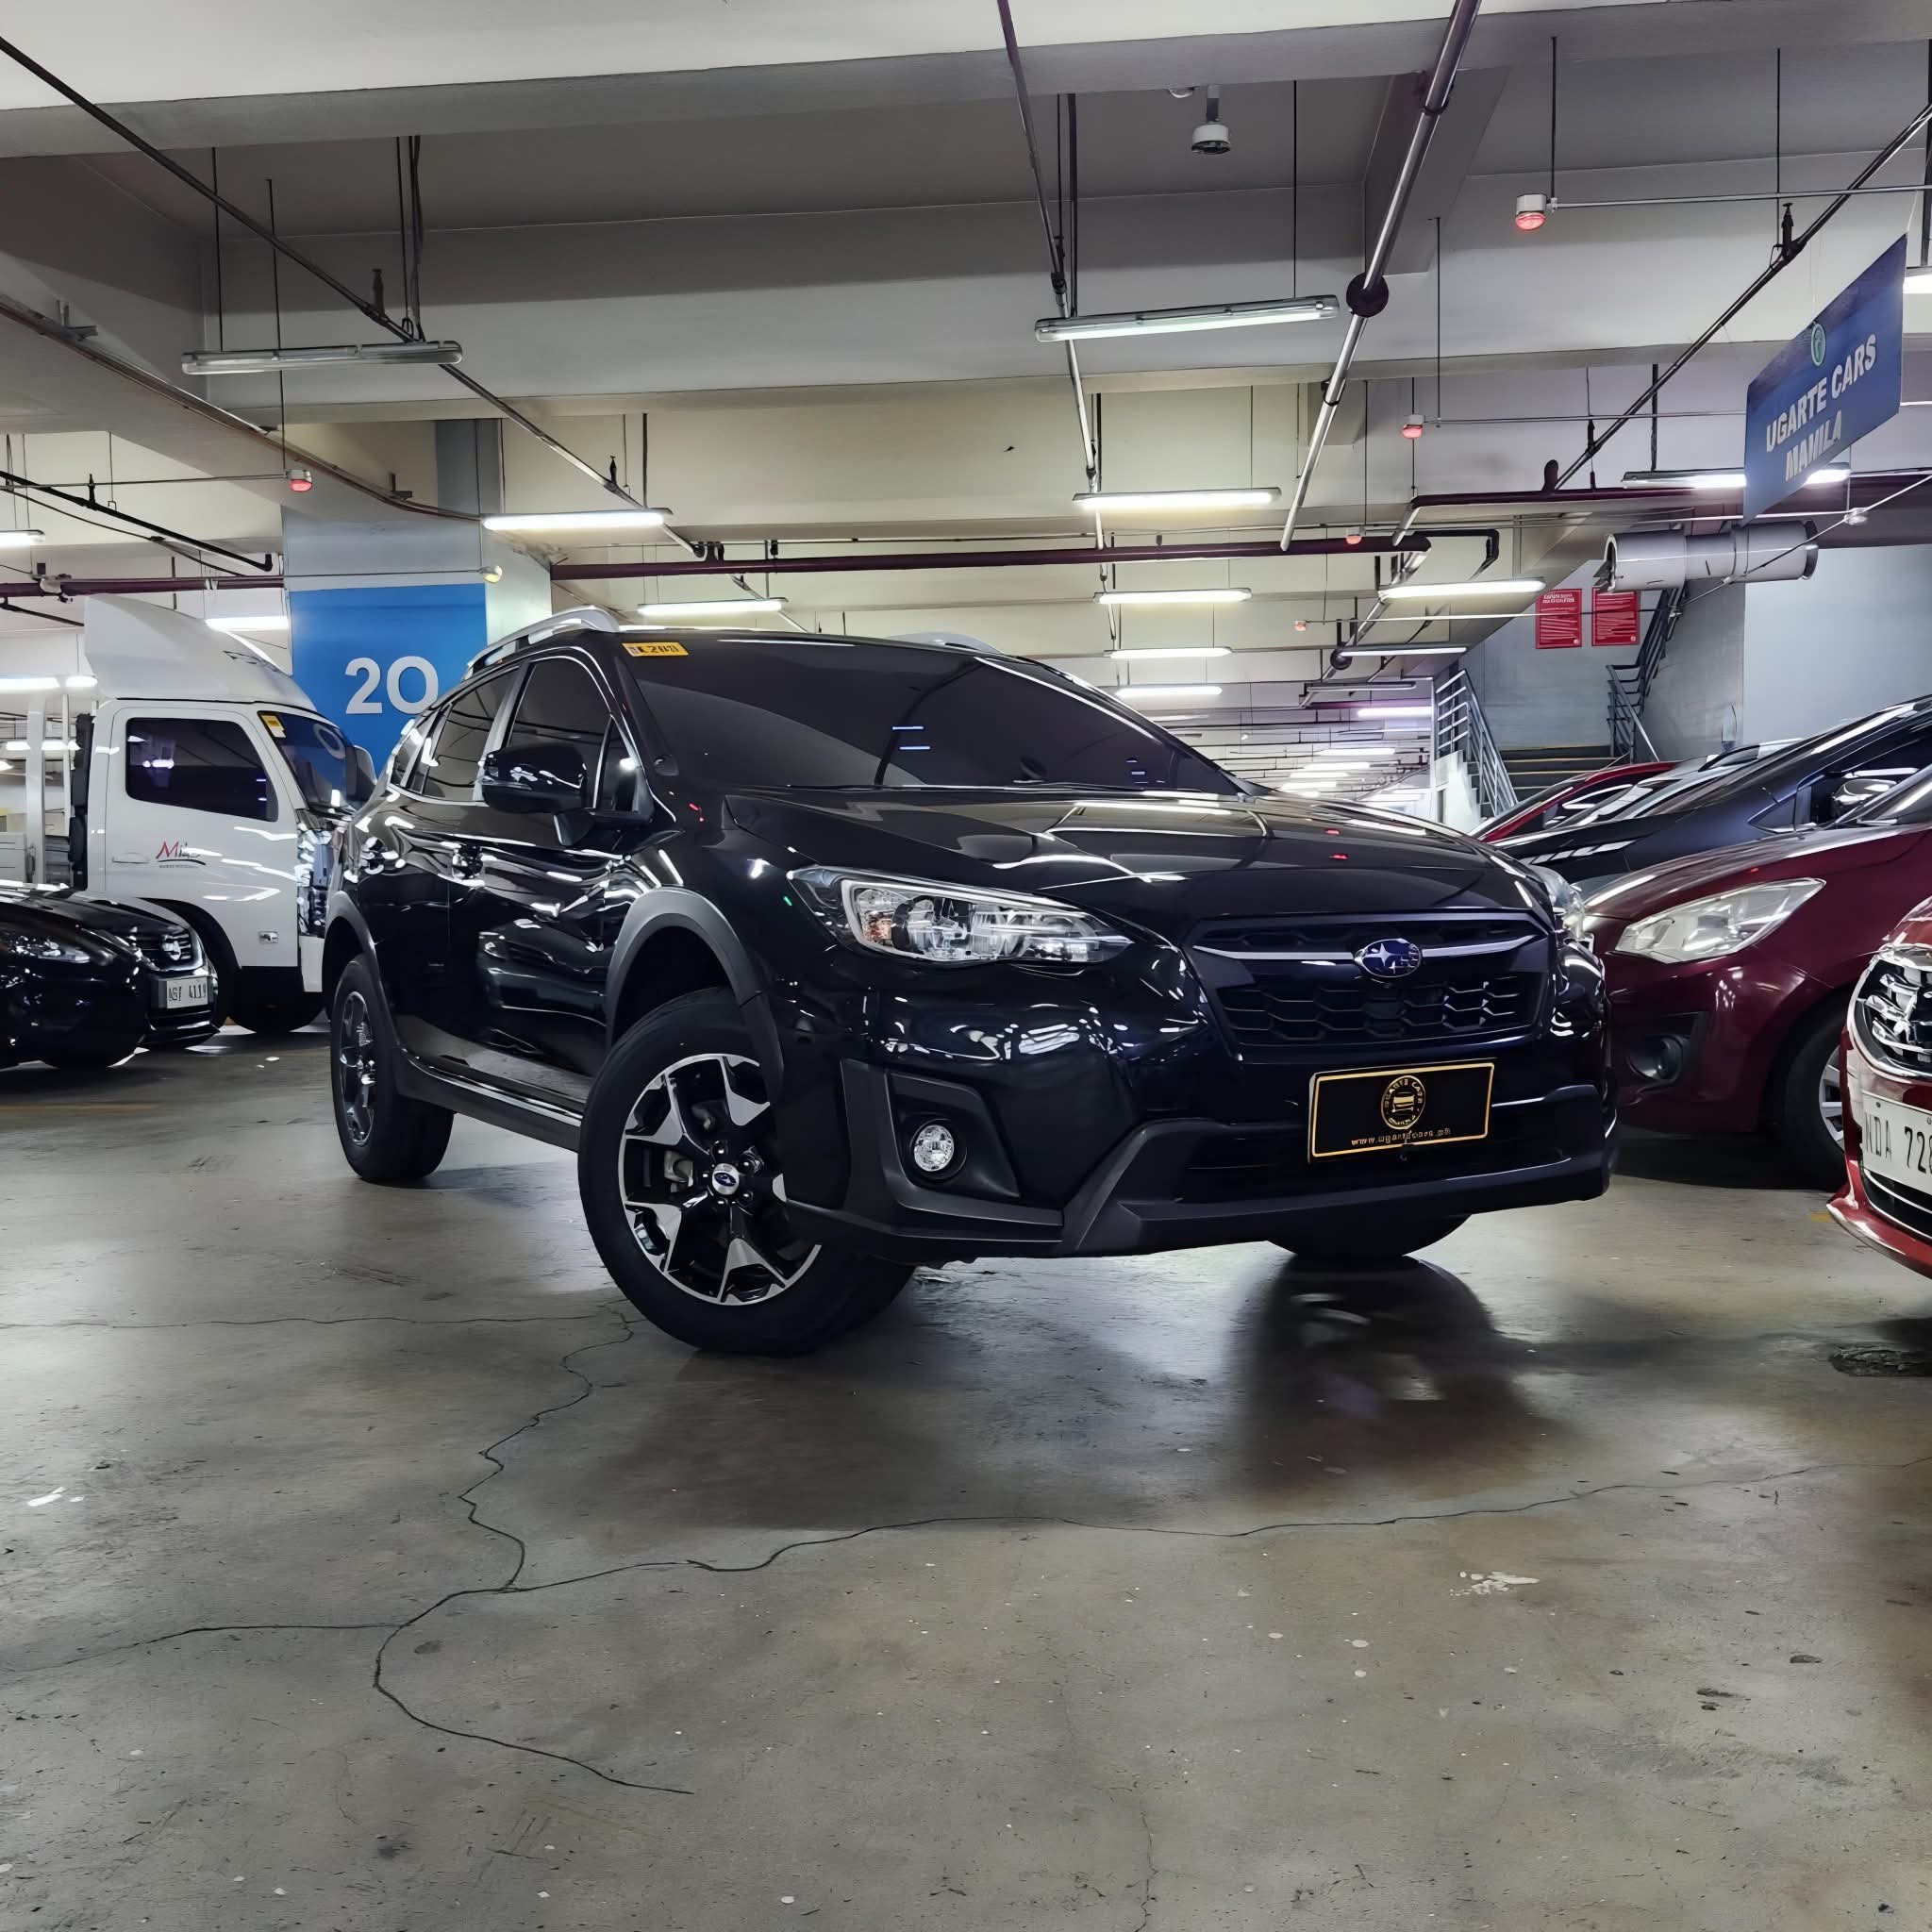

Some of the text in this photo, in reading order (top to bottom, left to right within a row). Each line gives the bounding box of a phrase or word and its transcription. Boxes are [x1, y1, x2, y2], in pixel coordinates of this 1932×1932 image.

[1766, 334, 1876, 453] UGARTE CARS
[1786, 409, 1842, 482] MANILA
[344, 656, 439, 715] 20
